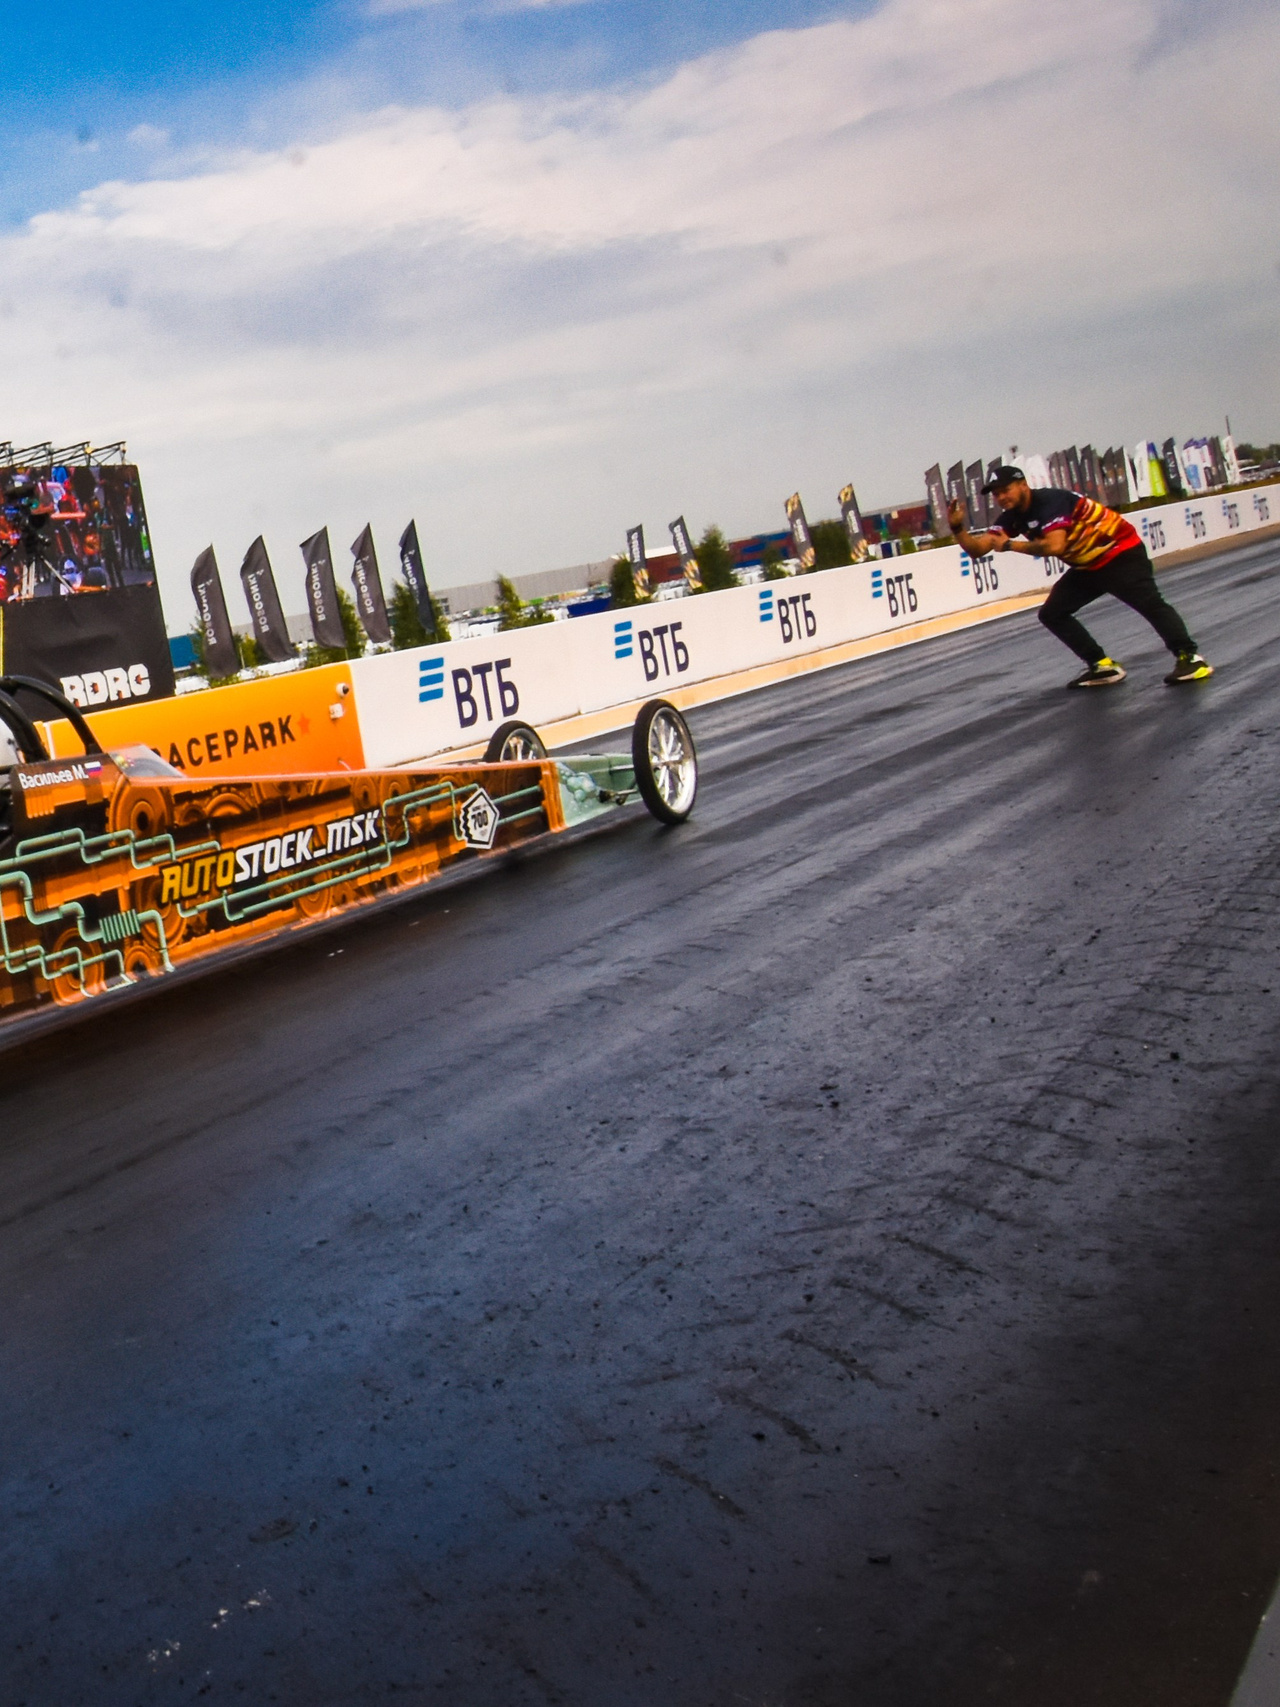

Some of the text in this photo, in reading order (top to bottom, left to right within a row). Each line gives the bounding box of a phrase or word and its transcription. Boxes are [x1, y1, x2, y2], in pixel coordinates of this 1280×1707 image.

[777, 592, 817, 644] ВТБ
[885, 573, 918, 618] ВТБ
[638, 621, 690, 682] ВТБ
[59, 663, 151, 708] RDRC
[451, 658, 520, 728] ВТБ
[152, 714, 297, 771] ACEPARK
[18, 769, 74, 789] Васильев
